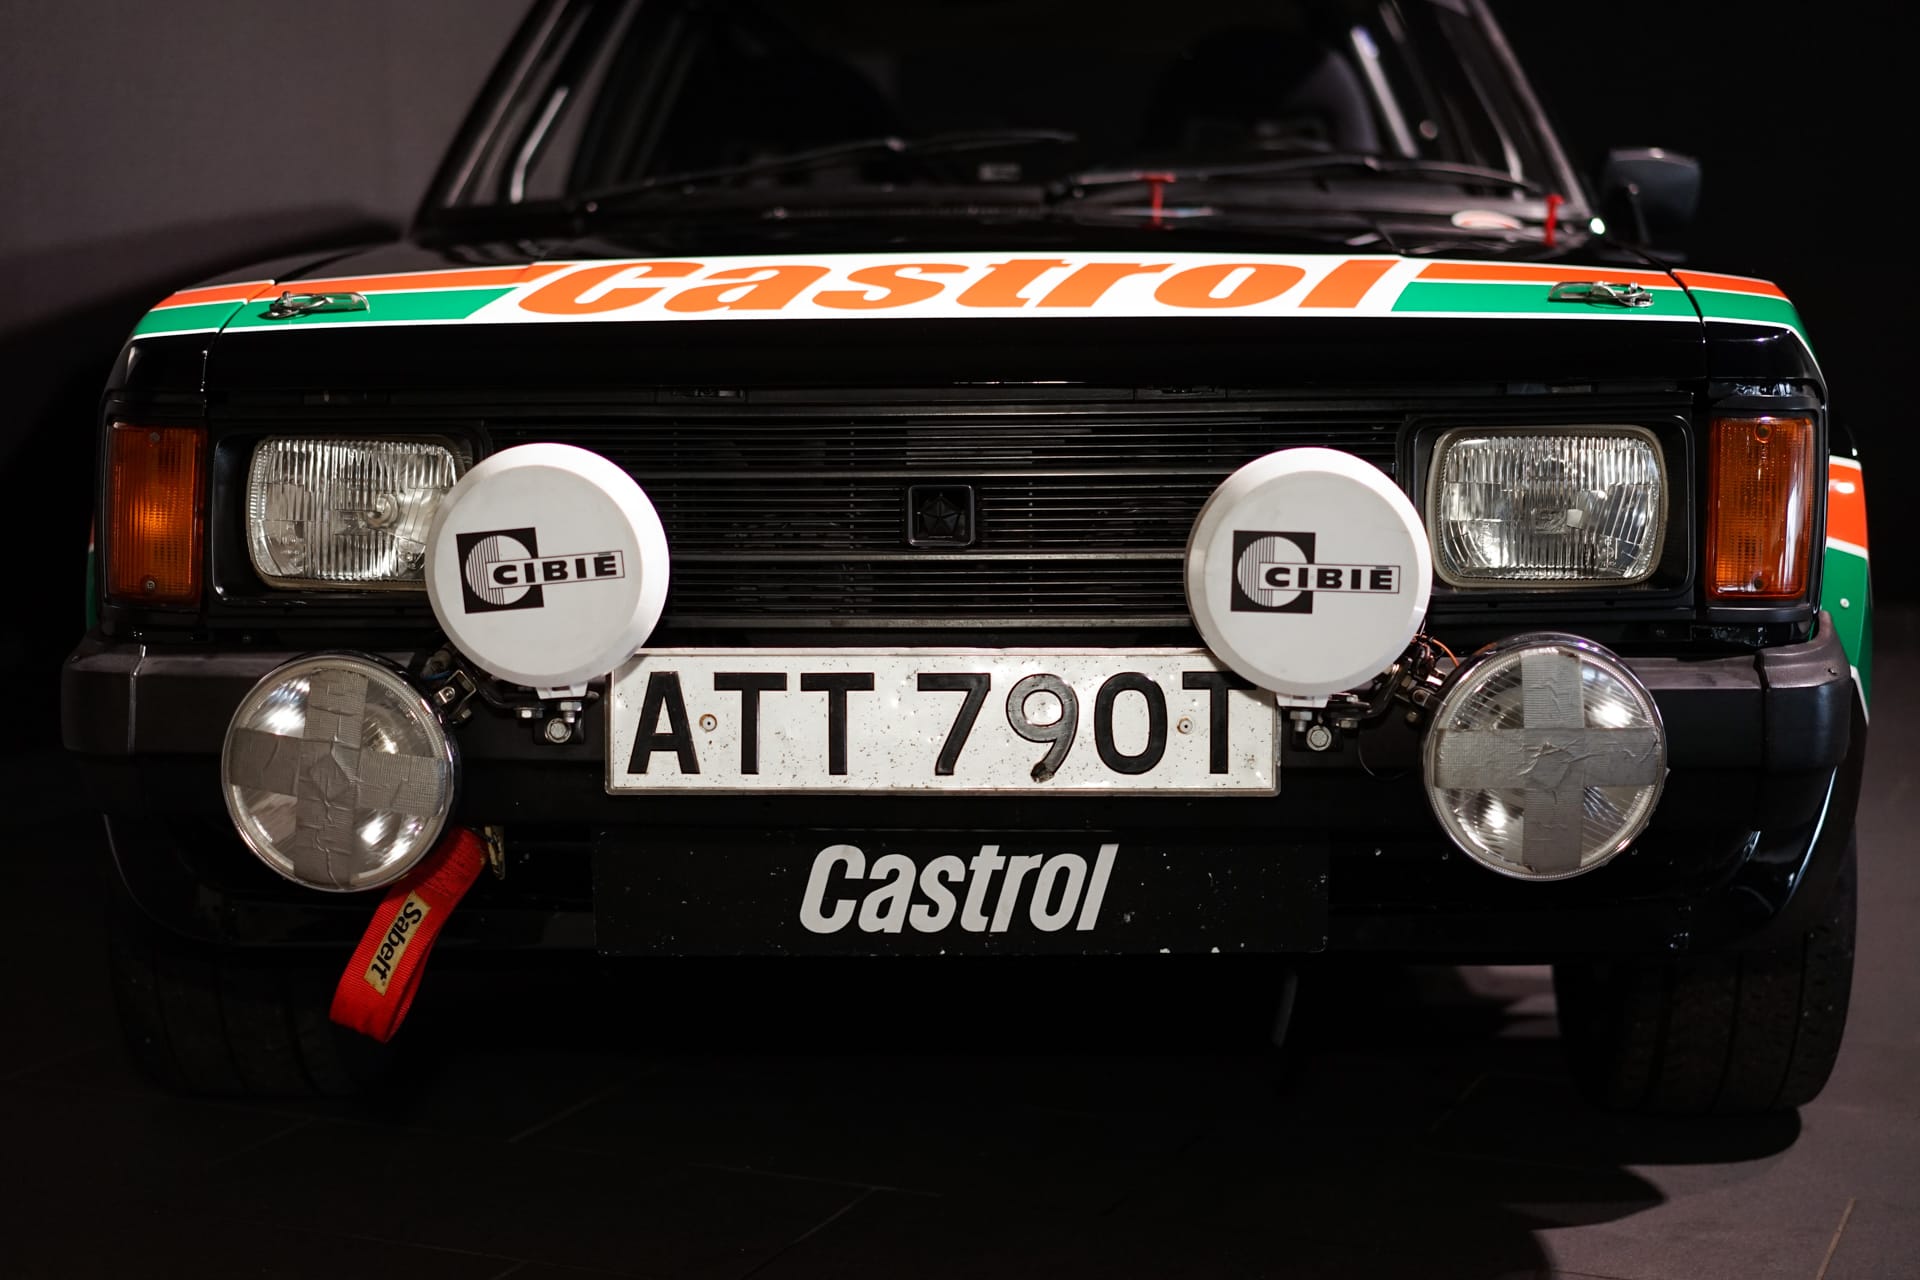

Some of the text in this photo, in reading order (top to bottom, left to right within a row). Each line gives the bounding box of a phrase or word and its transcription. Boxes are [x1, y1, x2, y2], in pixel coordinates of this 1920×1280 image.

[626, 671, 1258, 783] ATT 790T
[799, 843, 1119, 934] Castrol
[371, 901, 422, 981] Sabelt
